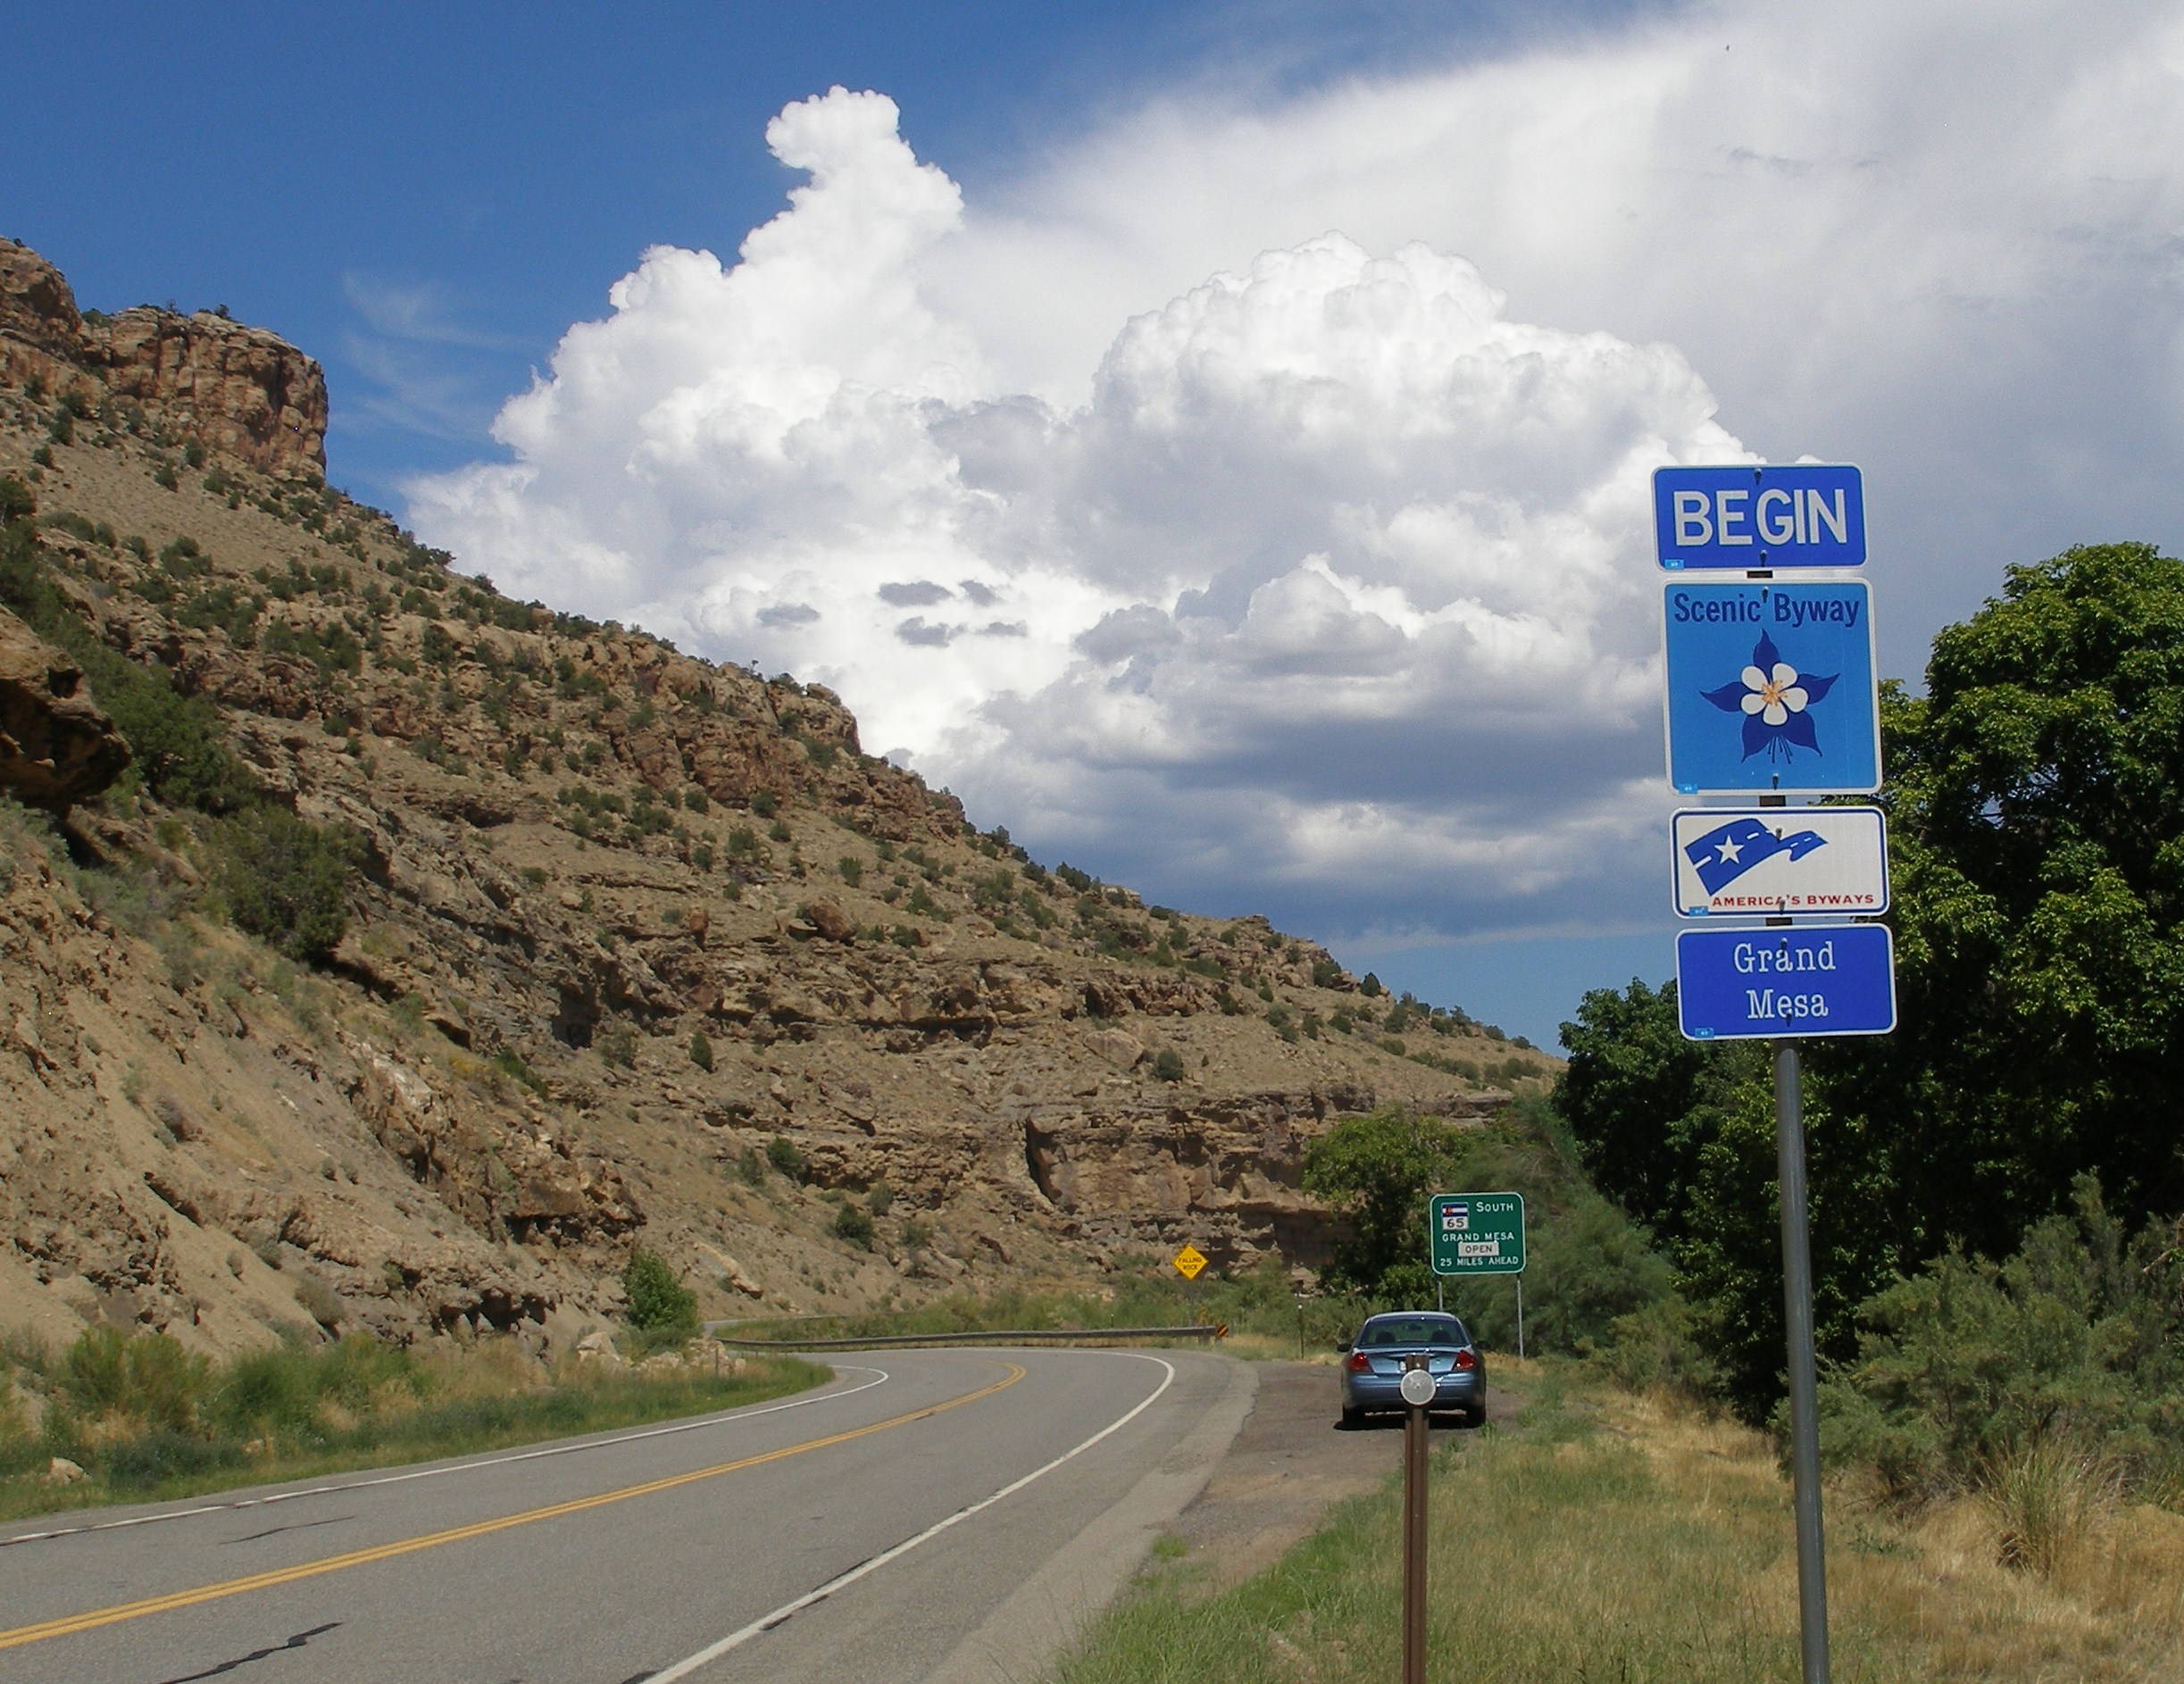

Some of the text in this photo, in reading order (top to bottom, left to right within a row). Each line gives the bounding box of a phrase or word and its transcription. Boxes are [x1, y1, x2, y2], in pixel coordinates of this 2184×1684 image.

[1673, 488, 1847, 546] BEGIN
[1674, 593, 1860, 628] Scenic Byway
[1807, 895, 1874, 905] BYWAYS
[1733, 940, 1837, 973] Grand
[1746, 988, 1829, 1019] Mesa
[1446, 1218, 1464, 1228] 65
[1442, 1232, 1514, 1242] GRAND MESA
[1465, 1245, 1493, 1254] OPEN
[1439, 1256, 1519, 1266] 25 MILES AHEAD
